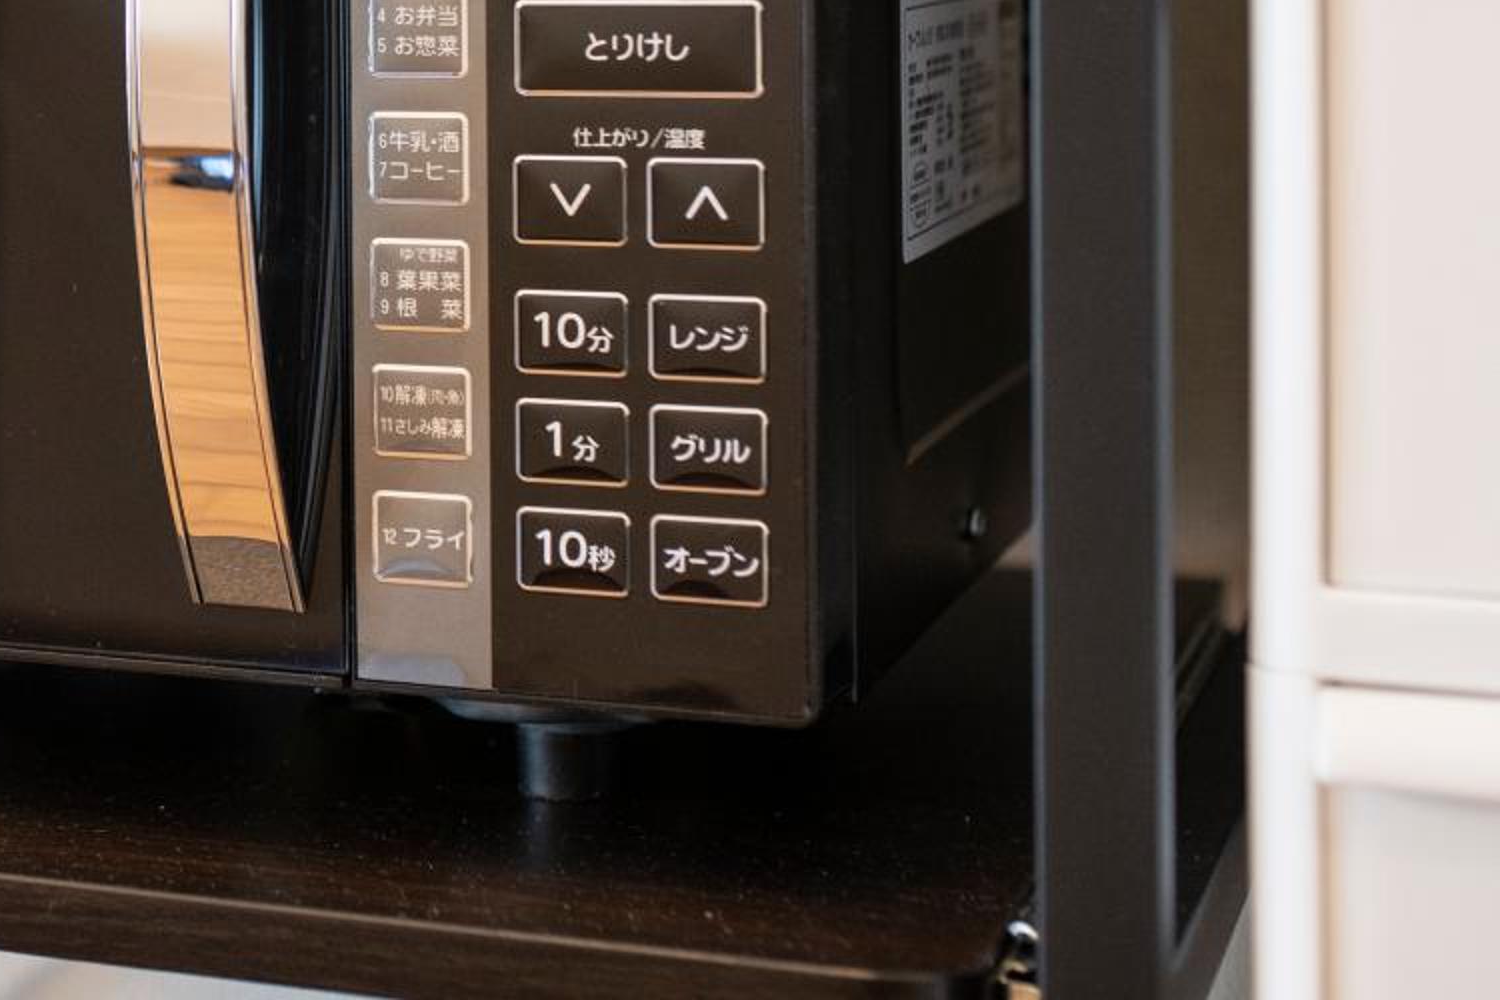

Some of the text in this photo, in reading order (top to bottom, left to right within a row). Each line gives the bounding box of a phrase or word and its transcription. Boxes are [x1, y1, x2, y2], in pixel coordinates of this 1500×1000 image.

[394, 5, 459, 27] お弁当
[394, 35, 460, 56] お惣菜
[584, 32, 690, 61] とりけし
[669, 323, 750, 353] レンジ
[670, 433, 751, 465] グリル
[663, 546, 759, 578] オーブン
